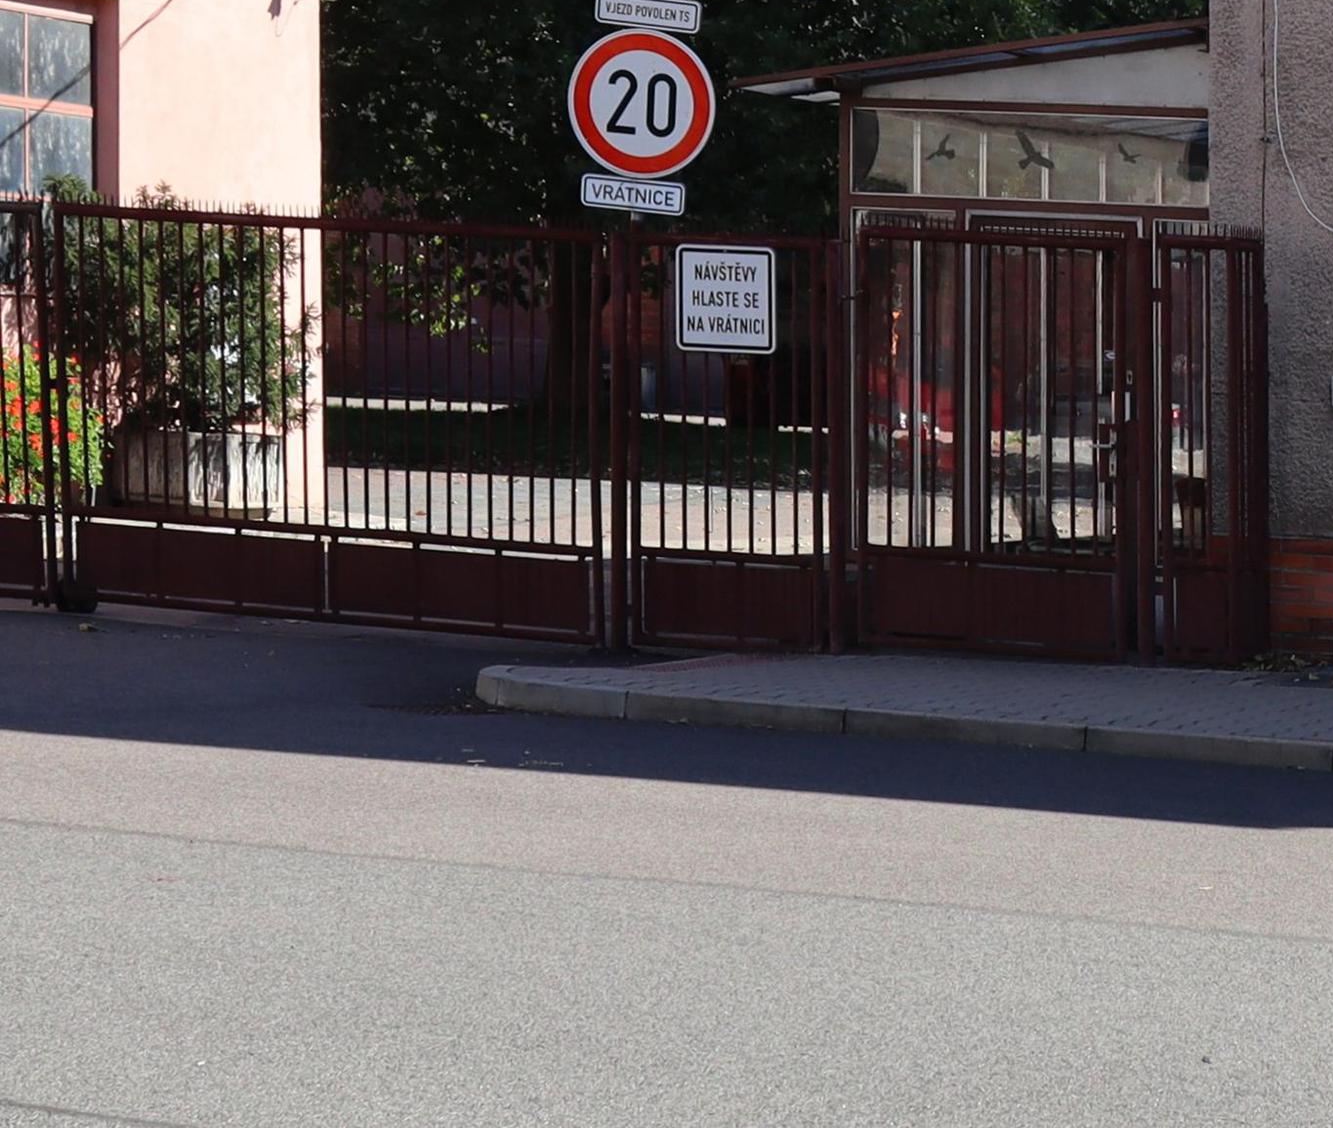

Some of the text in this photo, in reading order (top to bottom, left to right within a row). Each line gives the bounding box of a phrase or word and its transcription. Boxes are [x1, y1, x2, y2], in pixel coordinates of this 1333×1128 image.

[605, 1, 690, 23] VJEZD POVOLEN TS
[606, 69, 677, 137] 20
[592, 182, 675, 207] VRÁTNICE
[694, 260, 757, 282] NÁVŠTĚVY
[692, 290, 759, 308] HLASTE SE
[687, 314, 765, 335] NA VRÁTNICI
